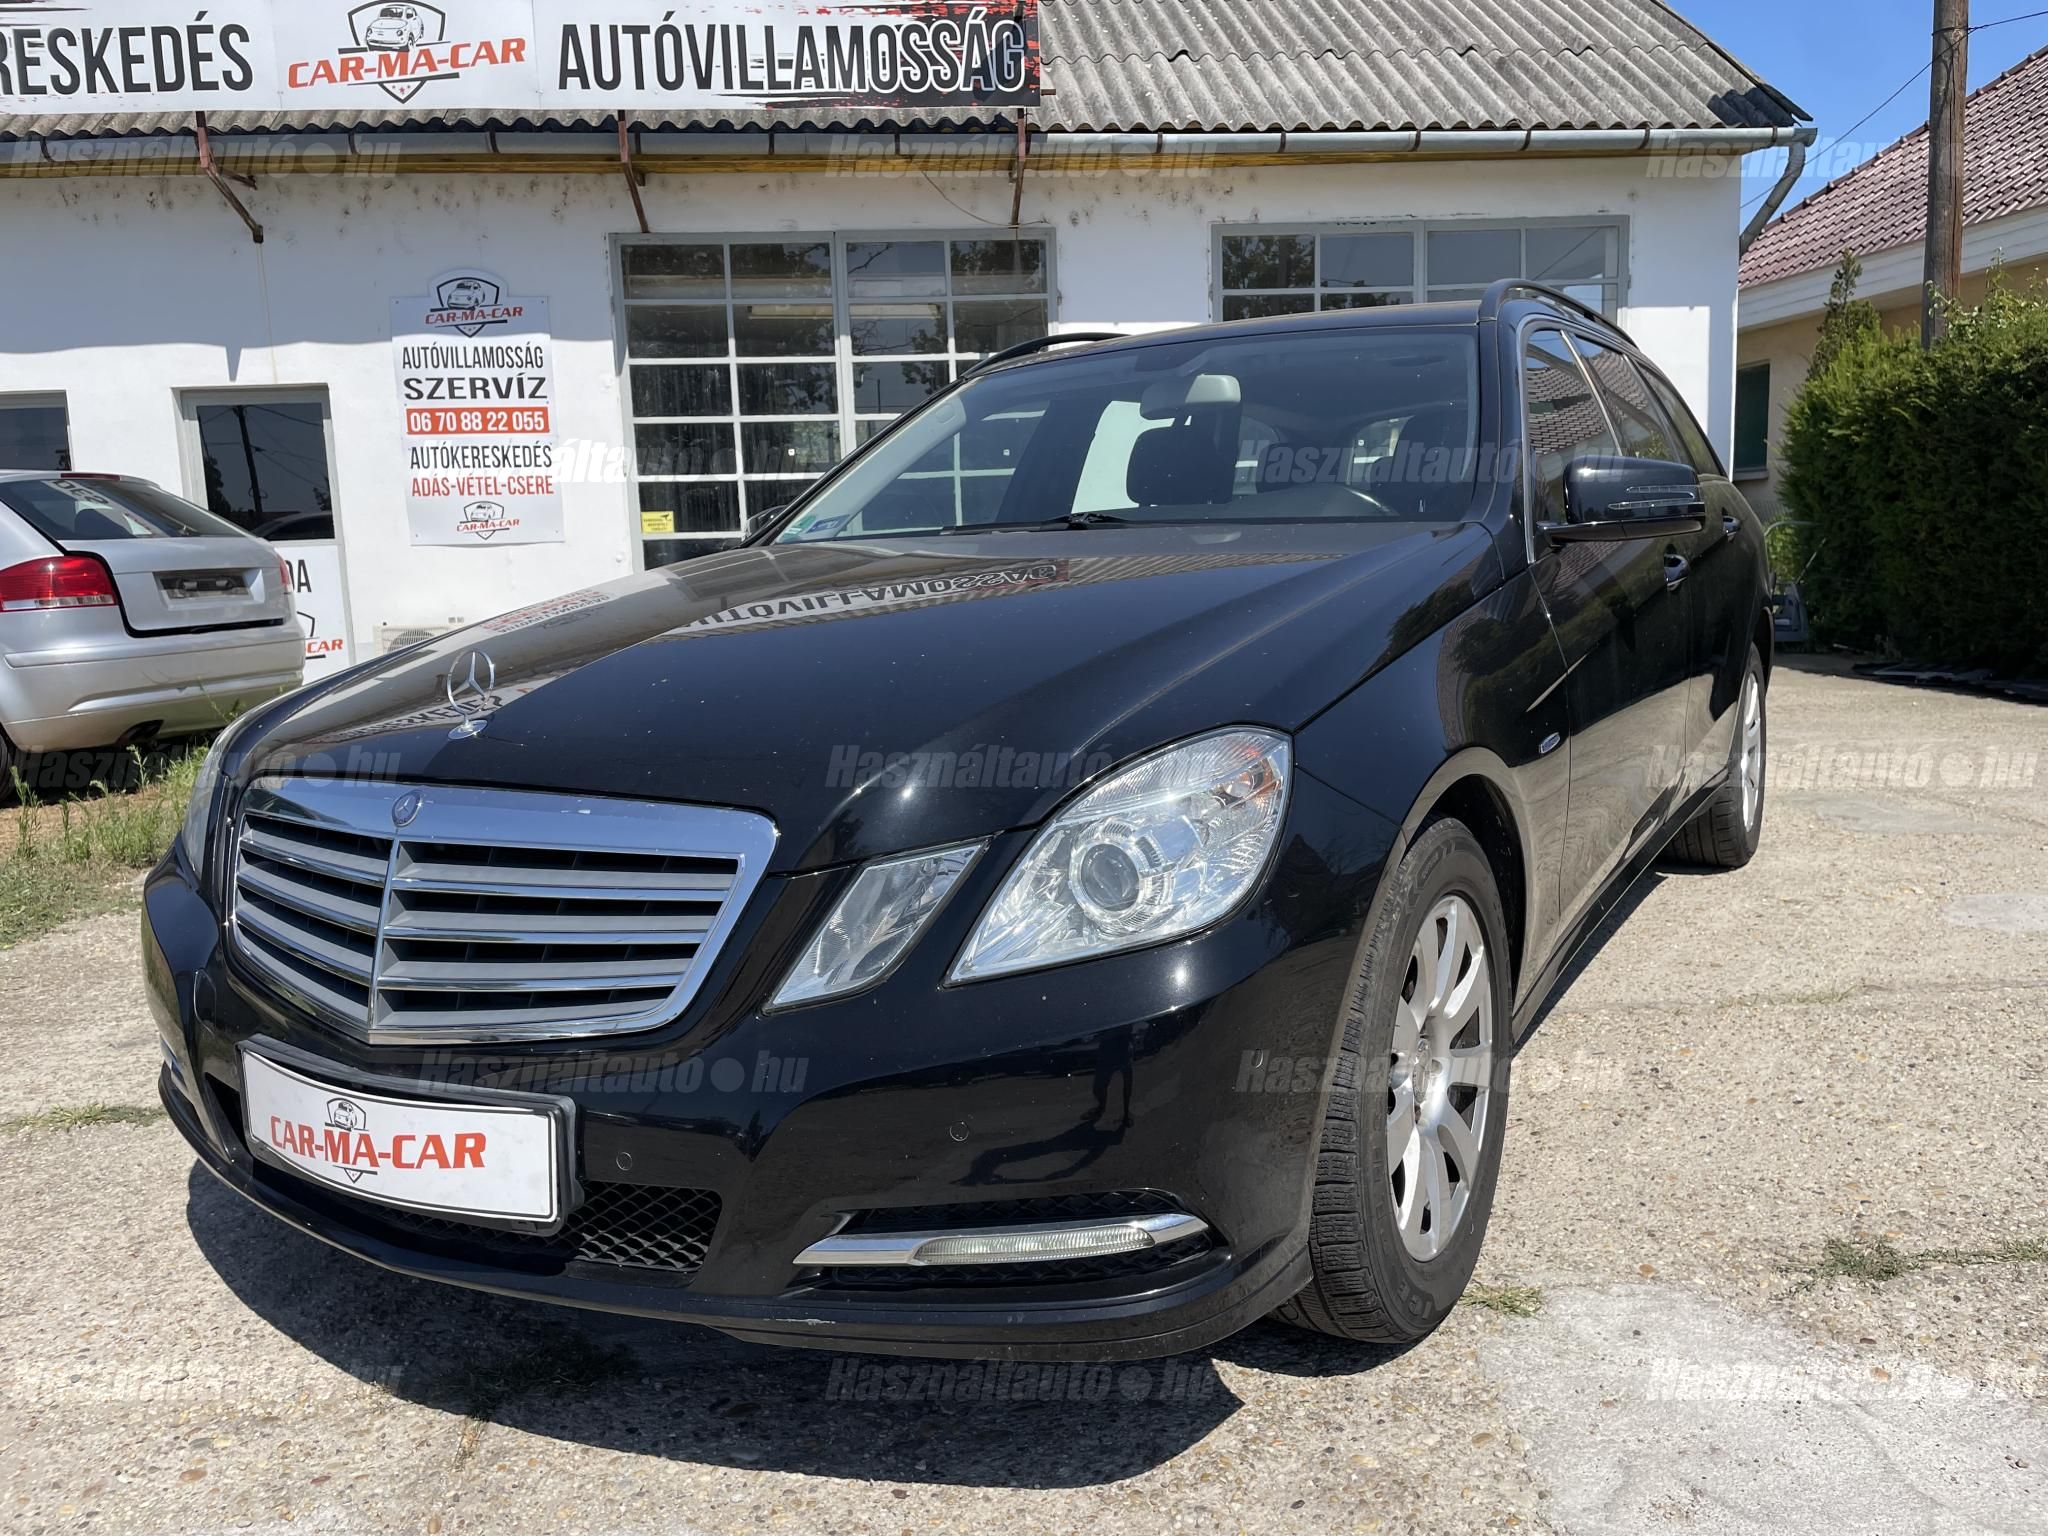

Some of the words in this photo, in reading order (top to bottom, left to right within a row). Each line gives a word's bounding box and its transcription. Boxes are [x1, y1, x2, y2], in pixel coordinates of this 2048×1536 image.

[288, 37, 526, 89] CAR-MA-CAR
[558, 7, 1025, 92] AUTÓVILLAMOSSÁG
[425, 306, 523, 325] CAR-MA-CAR
[402, 341, 544, 369] AUTÓVILLAMOSSÁG
[403, 372, 548, 400] SZERVÍZ
[410, 412, 433, 432] 06
[435, 412, 457, 432] 70
[460, 411, 483, 431] 88
[486, 411, 509, 431] 22
[512, 411, 545, 431] 055
[410, 440, 552, 469] AUTÓKERESKEDÉS
[412, 473, 554, 497] ADÁS-VÉTEL-CSERE
[456, 518, 520, 533] CAR-MA-CAR
[270, 1115, 487, 1169] CAR-MA-CAR
